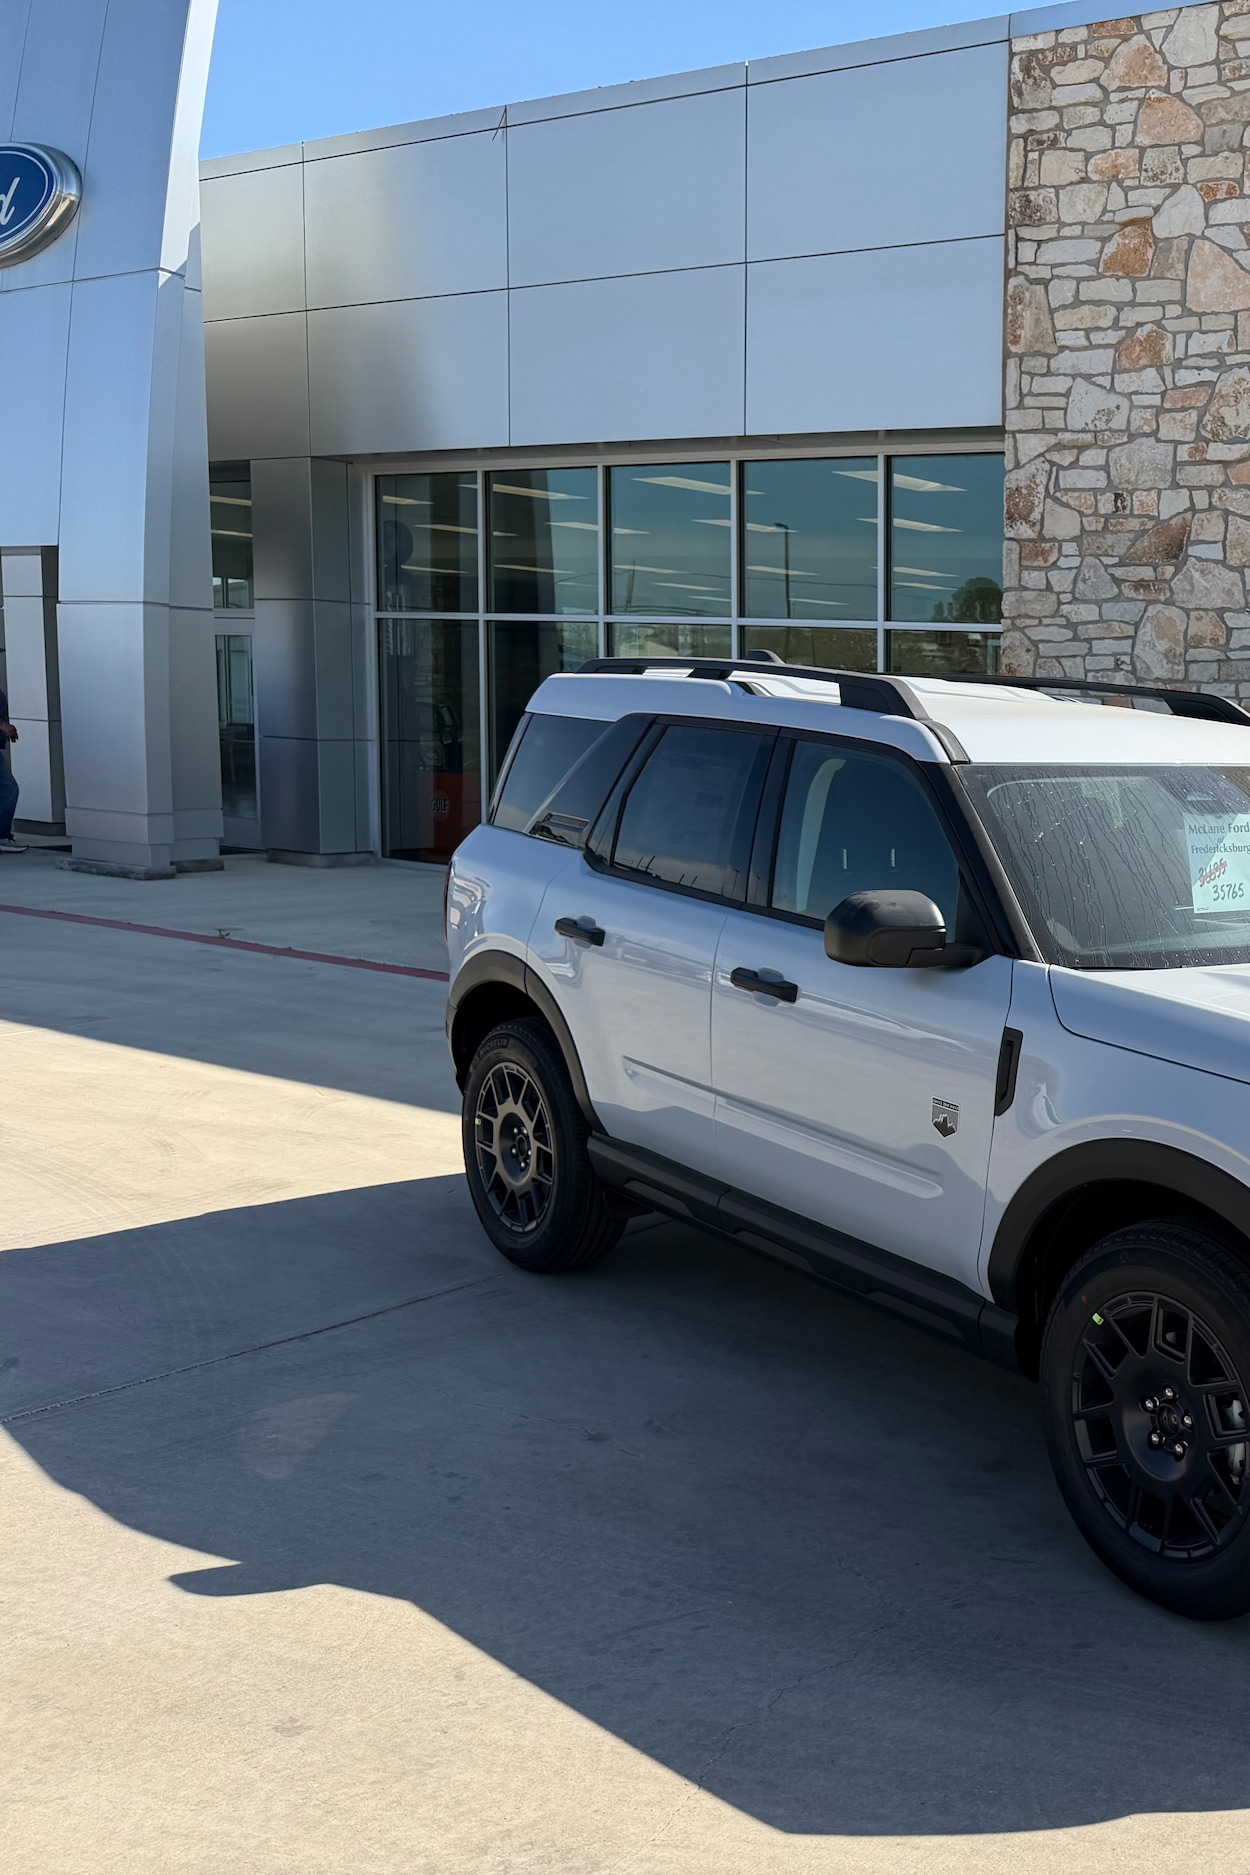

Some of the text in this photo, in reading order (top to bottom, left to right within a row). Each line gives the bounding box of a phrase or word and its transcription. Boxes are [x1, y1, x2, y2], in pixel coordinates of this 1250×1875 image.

[1188, 822, 1250, 835] McLane Ford
[1212, 882, 1244, 902] 35765
